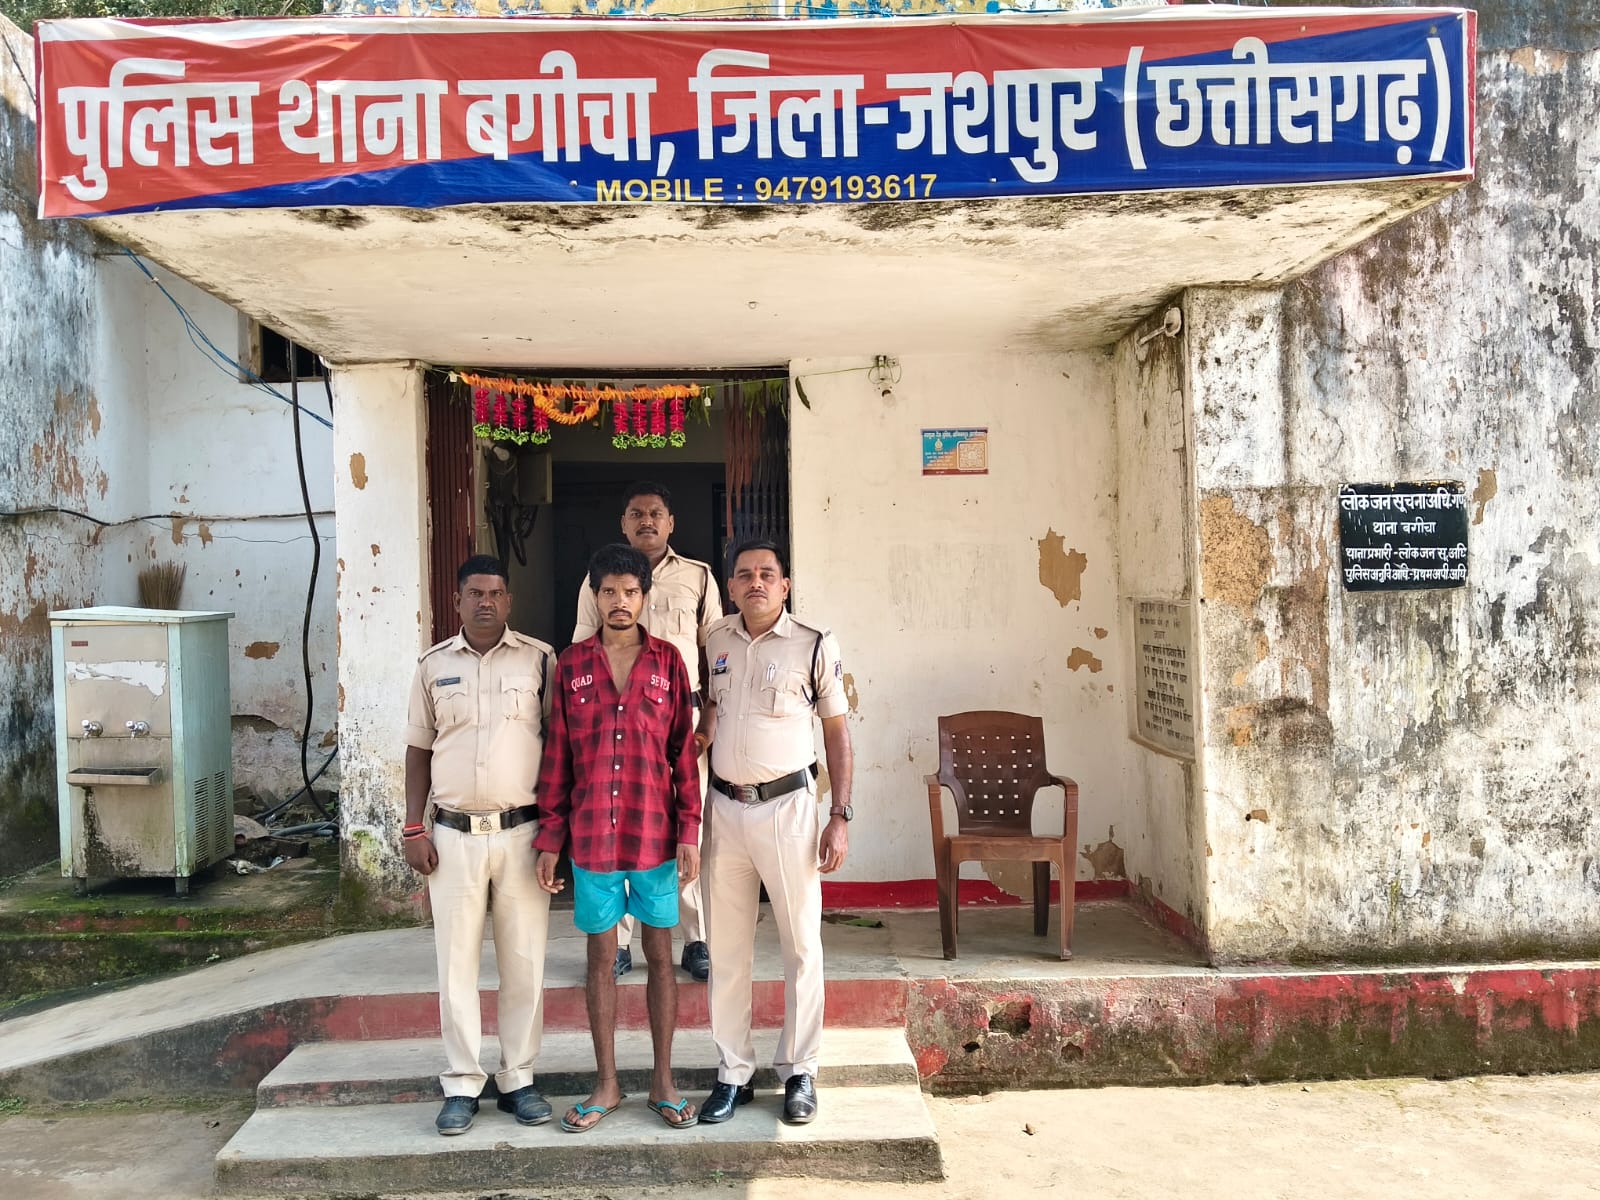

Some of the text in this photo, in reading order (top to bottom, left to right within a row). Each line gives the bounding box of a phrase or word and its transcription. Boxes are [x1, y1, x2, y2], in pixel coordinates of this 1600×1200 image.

[58, 57, 260, 202] पुलिस
[278, 79, 449, 164] थाना
[458, 50, 676, 178] बगीचा,
[1123, 36, 1452, 171] (छत्तीसगढ़)
[595, 178, 724, 202] MOBILE
[754, 173, 938, 201] 9479193617
[1370, 494, 1391, 510] जन
[1372, 521, 1398, 536] थाना
[571, 674, 593, 692] QUAD
